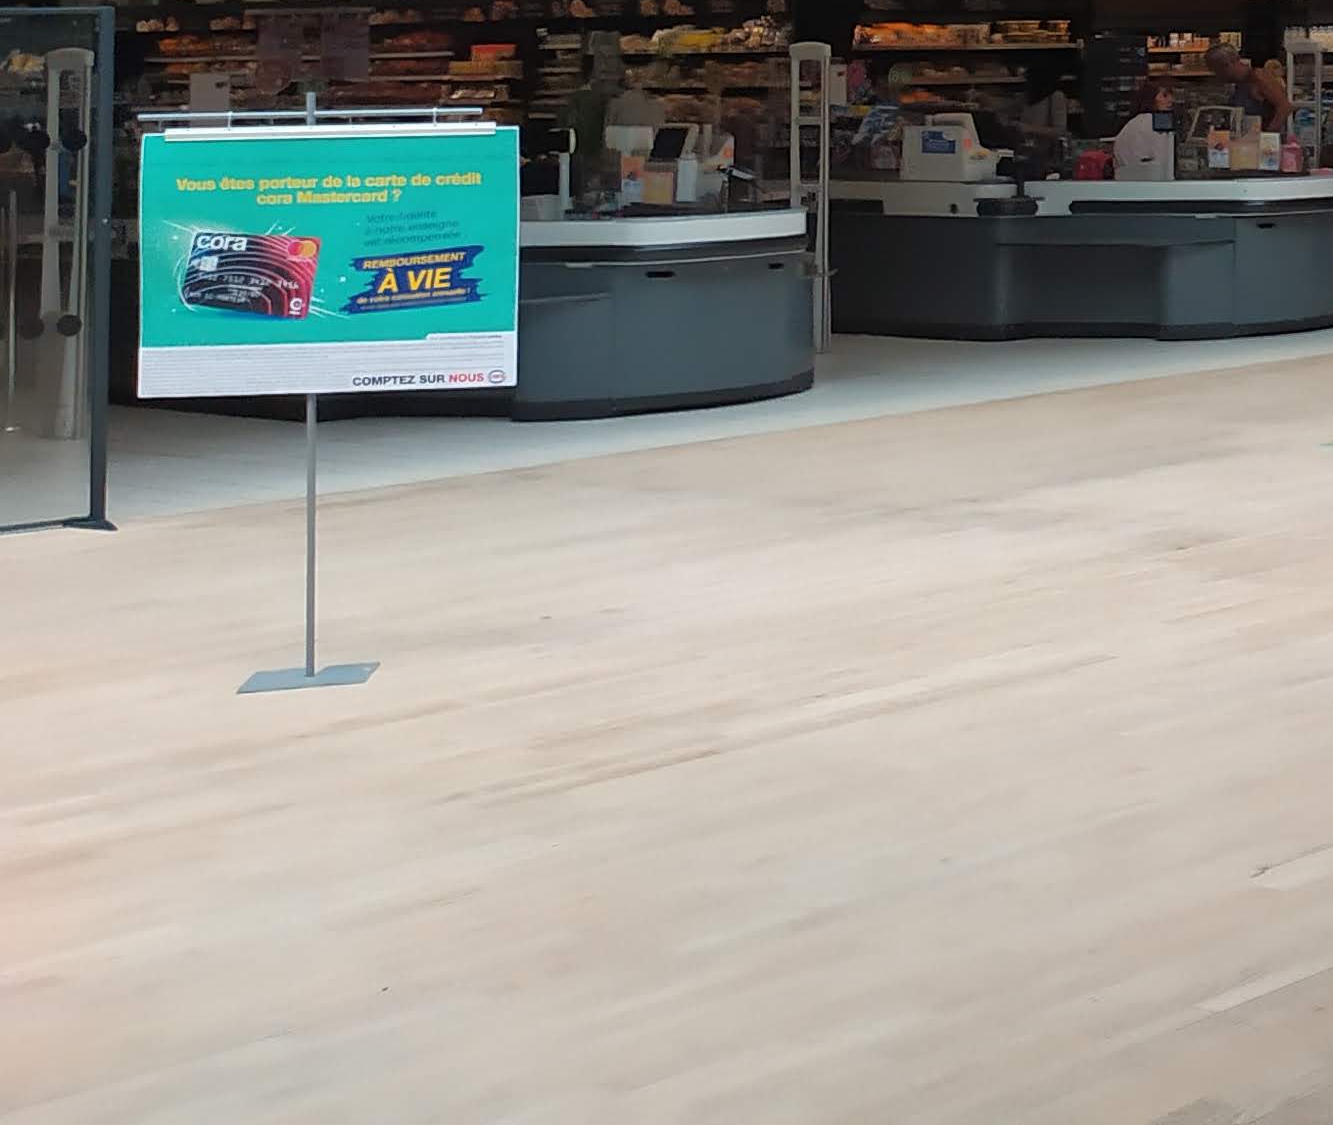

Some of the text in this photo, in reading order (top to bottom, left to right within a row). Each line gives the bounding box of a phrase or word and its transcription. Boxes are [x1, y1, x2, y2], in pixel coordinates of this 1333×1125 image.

[176, 171, 482, 192] Vous êtes porteur de la carte de crédit
[256, 190, 402, 205] cora Mastercard ?
[196, 234, 248, 252] cora
[362, 251, 467, 270] REMBOURSEMENT
[377, 267, 453, 294] À VIE
[352, 374, 416, 387] COMPTEZ
[419, 373, 445, 385] SUR
[448, 372, 485, 384] NOUS
